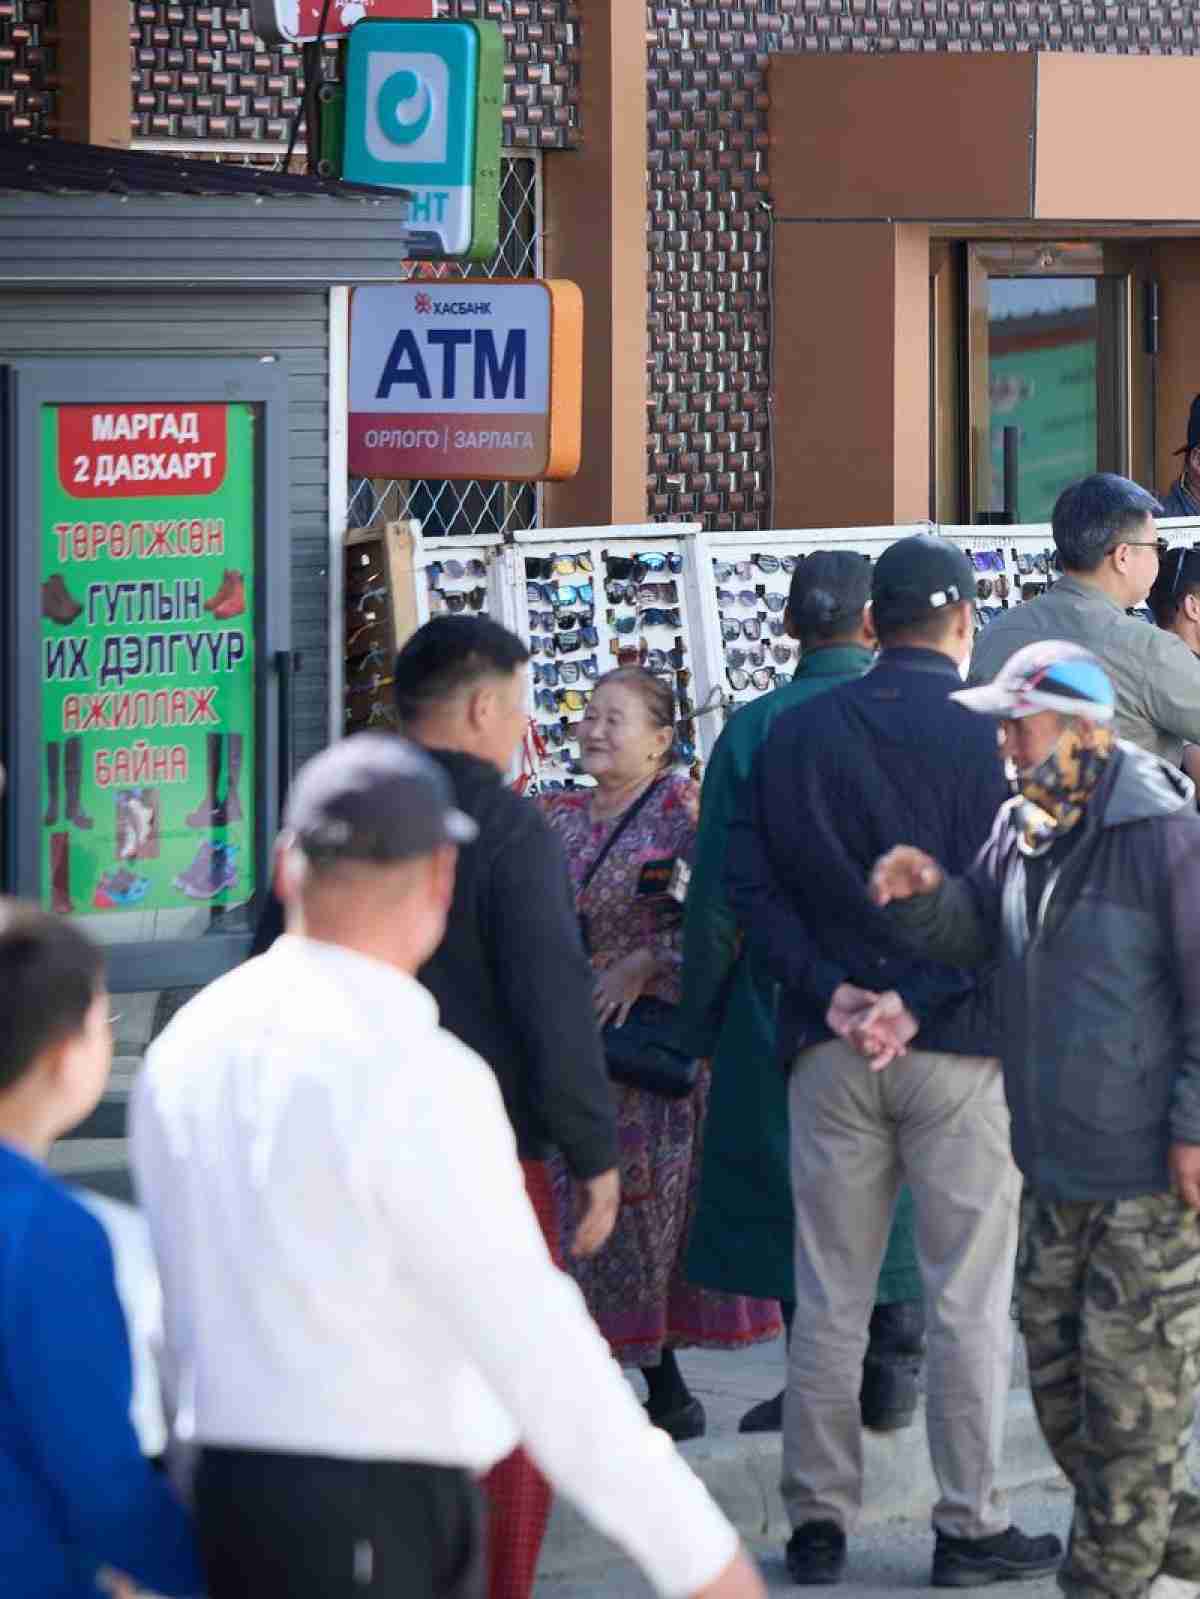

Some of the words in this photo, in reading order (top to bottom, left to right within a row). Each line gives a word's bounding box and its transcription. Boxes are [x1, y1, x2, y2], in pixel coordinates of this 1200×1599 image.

[408, 191, 449, 225] НТ
[433, 301, 492, 316] ХАСБАНК
[92, 412, 200, 444] МАРГАД
[365, 429, 440, 449] ОРЛОГО
[454, 430, 535, 450] ЗАРЛАГА
[73, 455, 91, 483] 2
[93, 452, 217, 487] ДАВХАРТ
[54, 517, 225, 563] ТӨРӨЛЖСӨН
[87, 578, 203, 625] ГУТЛЫН
[44, 635, 91, 682] ИХ
[98, 628, 246, 689] ДЭЛГҮҮР
[63, 686, 221, 733] АЖИЛЛАЖ
[94, 739, 189, 789] БАЙНА
